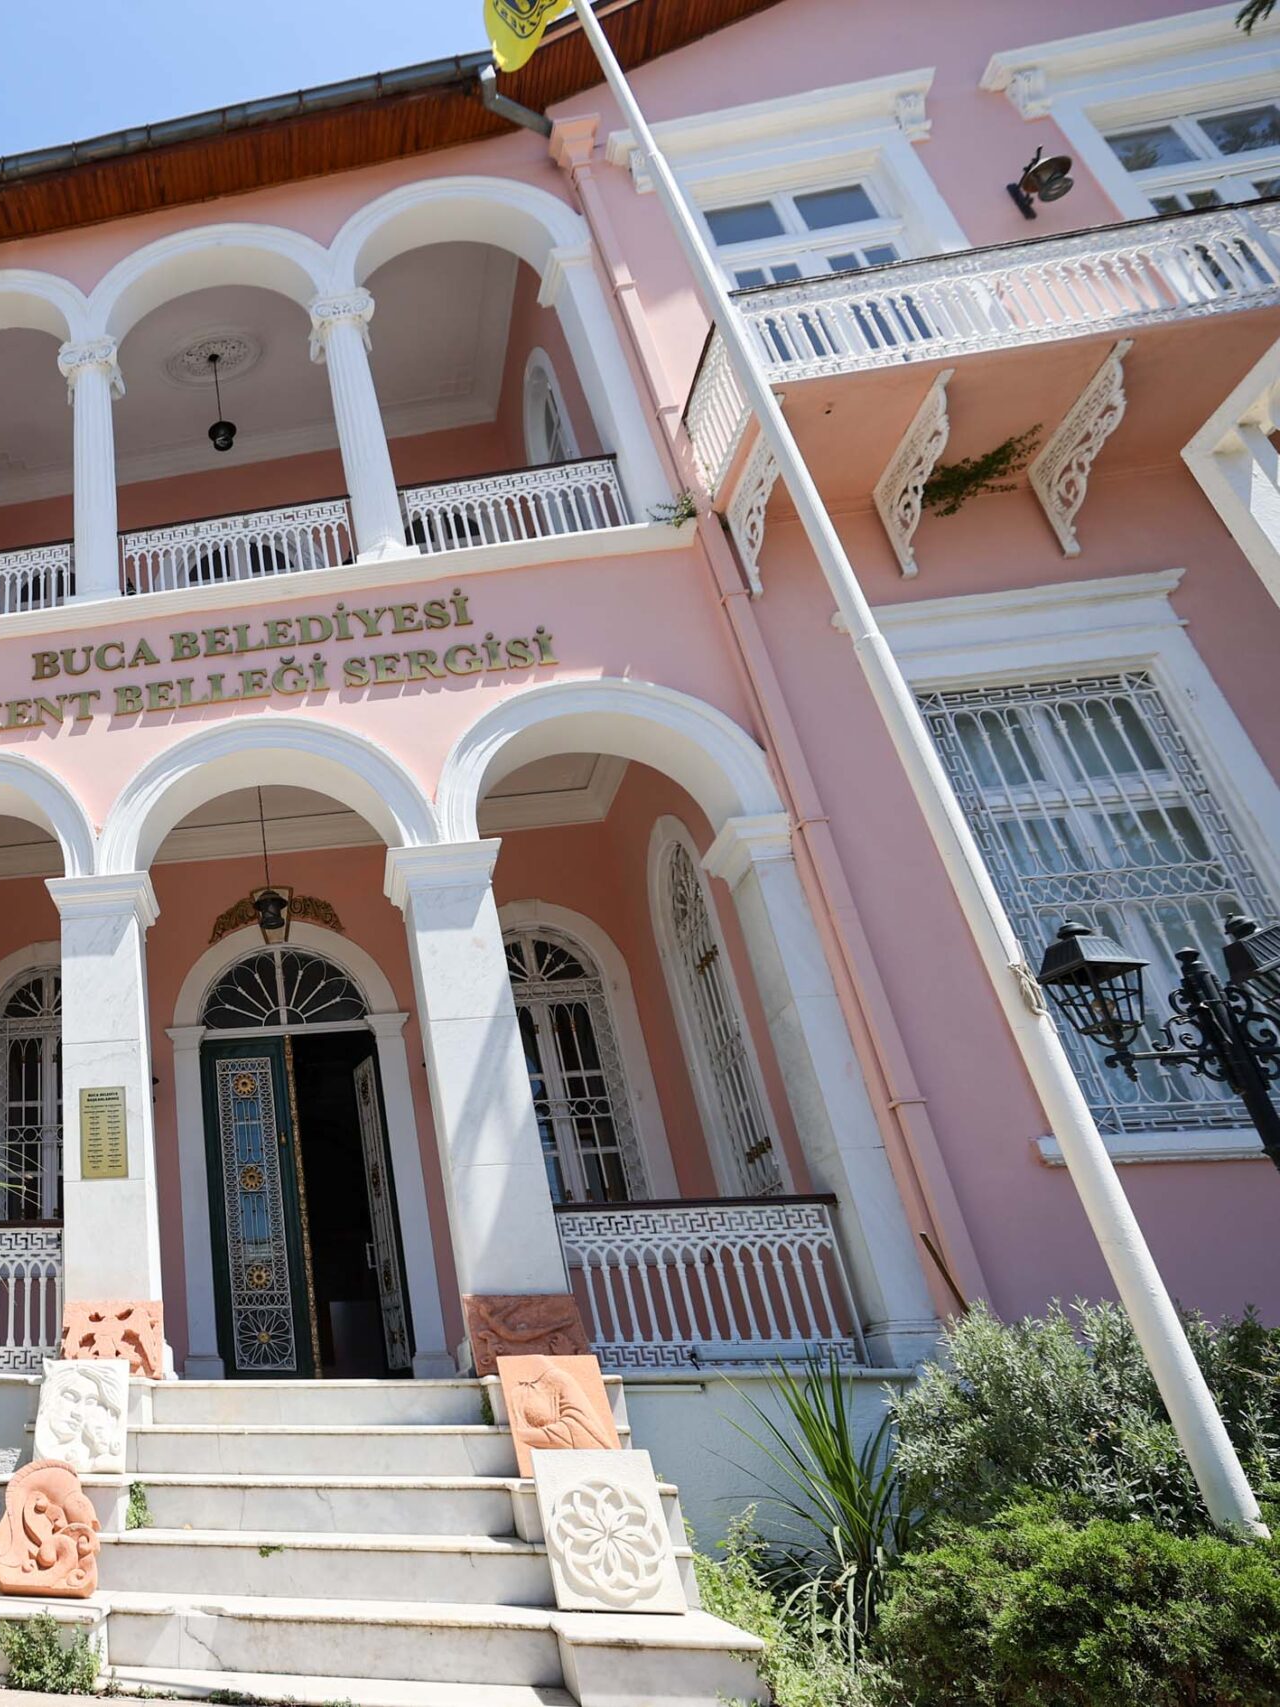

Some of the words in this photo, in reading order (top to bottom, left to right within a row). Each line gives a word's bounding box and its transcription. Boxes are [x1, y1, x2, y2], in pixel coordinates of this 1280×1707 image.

[31, 638, 161, 680] BUCA
[169, 587, 474, 662] BELEDİYESİ
[113, 652, 331, 717] BELLEĞİ
[343, 625, 560, 688] SERGİSİ
